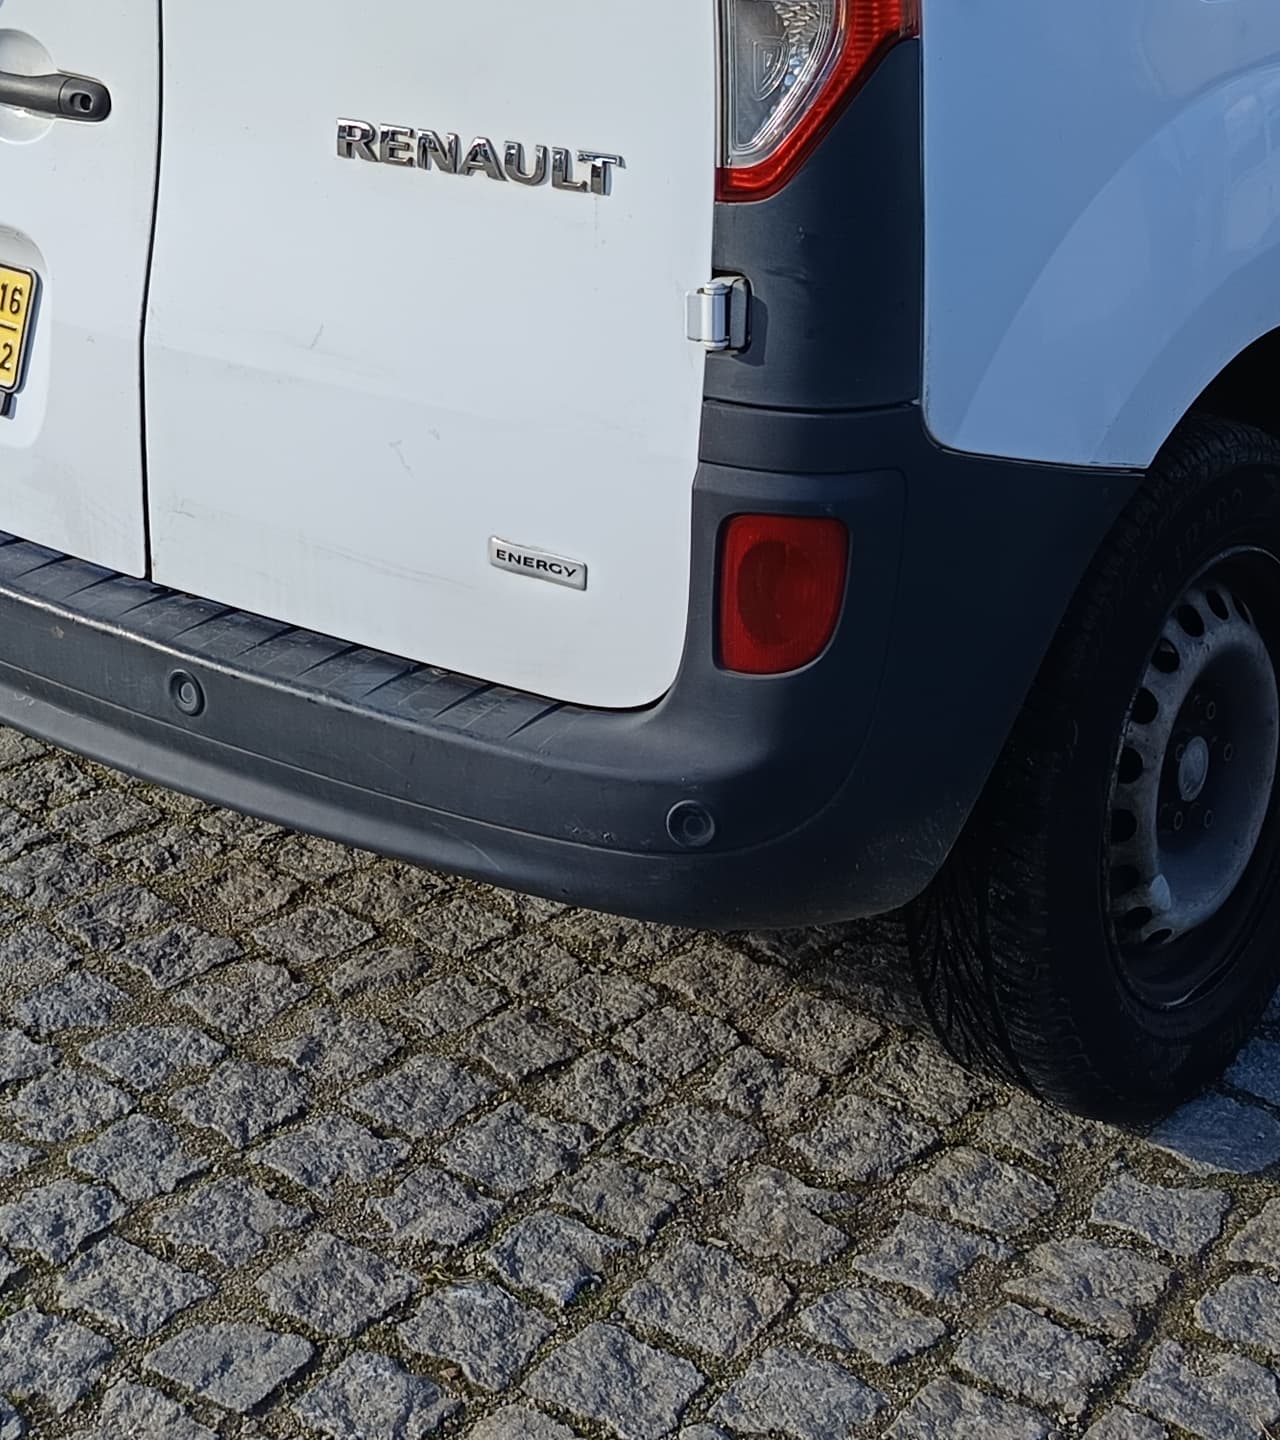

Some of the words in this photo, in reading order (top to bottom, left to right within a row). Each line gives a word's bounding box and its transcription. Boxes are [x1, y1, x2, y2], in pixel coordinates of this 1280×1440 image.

[336, 117, 626, 196] RENAULT
[0, 283, 23, 315] 16
[496, 548, 577, 577] ENERGY
